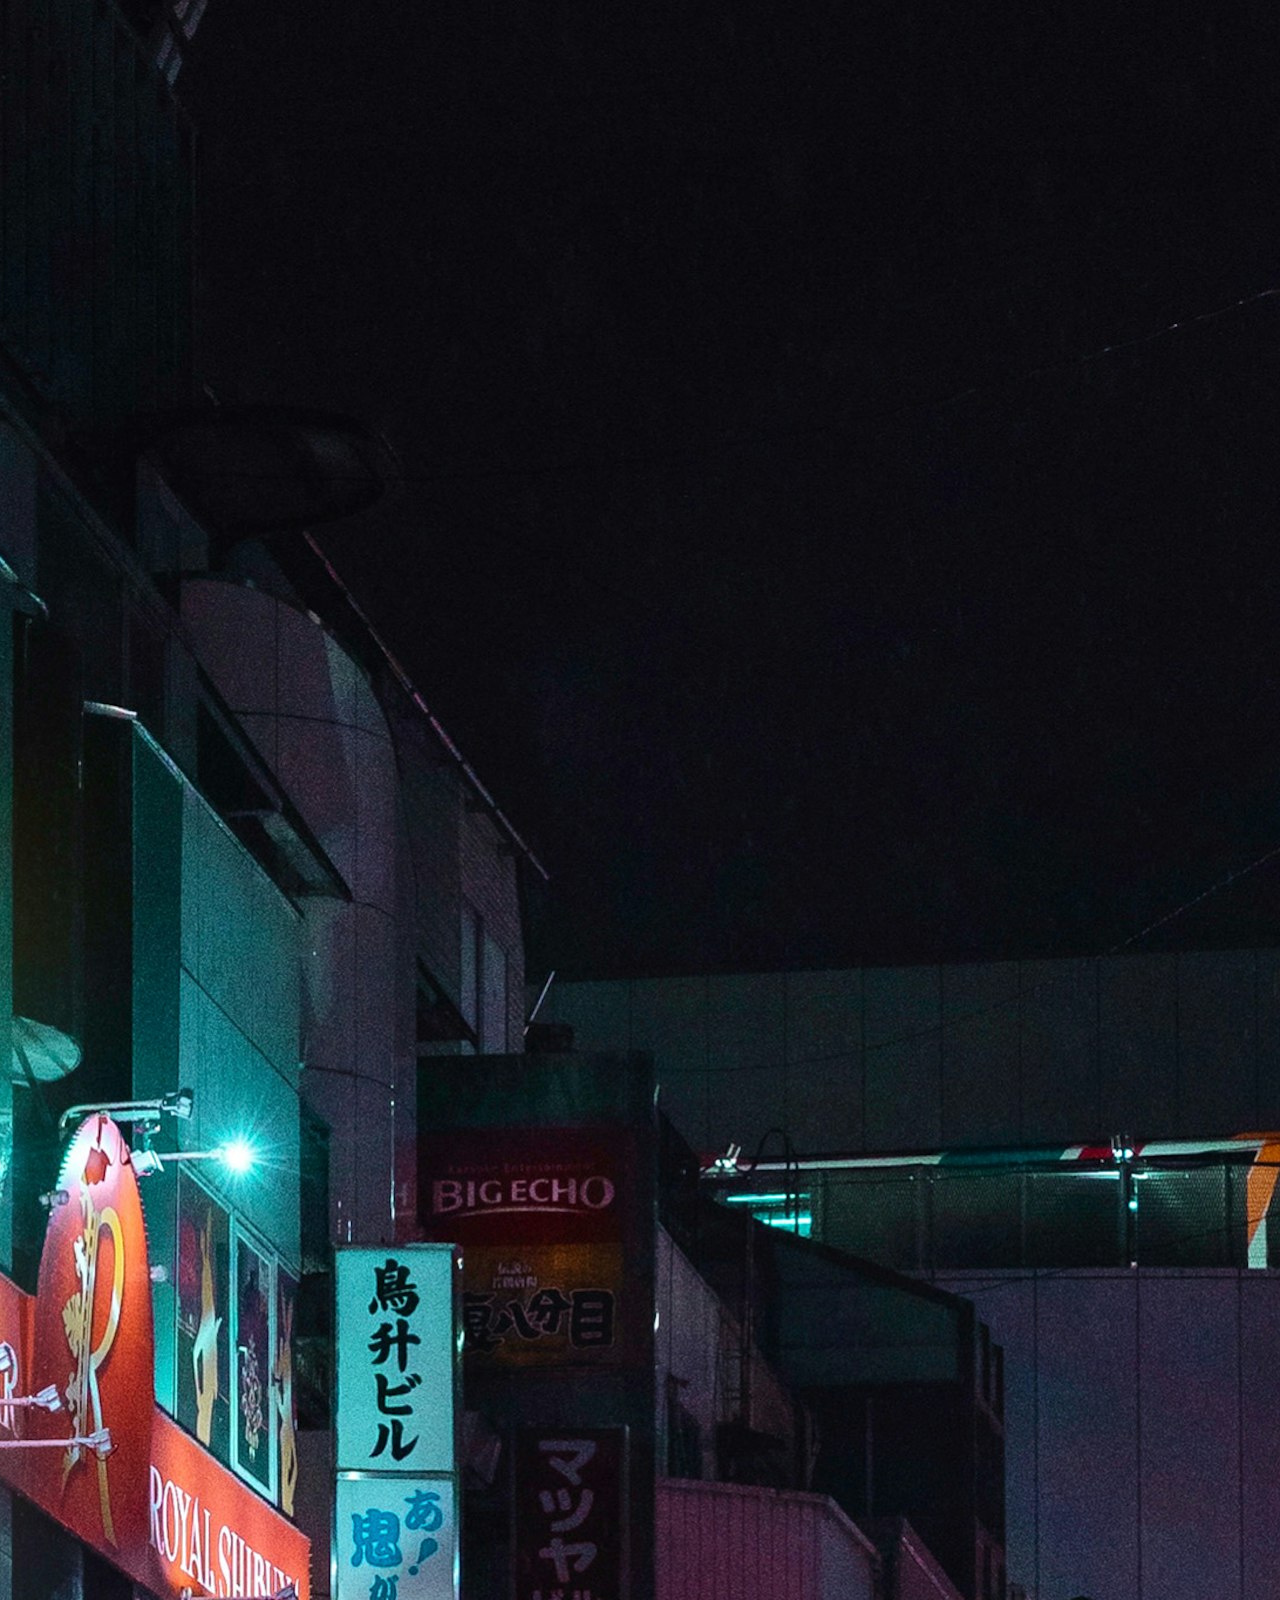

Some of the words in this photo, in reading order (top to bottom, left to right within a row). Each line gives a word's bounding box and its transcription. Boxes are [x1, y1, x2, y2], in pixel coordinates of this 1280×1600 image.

[431, 1179, 502, 1214] BIG
[510, 1175, 615, 1210] ECHO
[367, 1257, 422, 1462] 鳥升ビル
[148, 1464, 216, 1595] ROYAL
[537, 1438, 599, 1585] マツヤ
